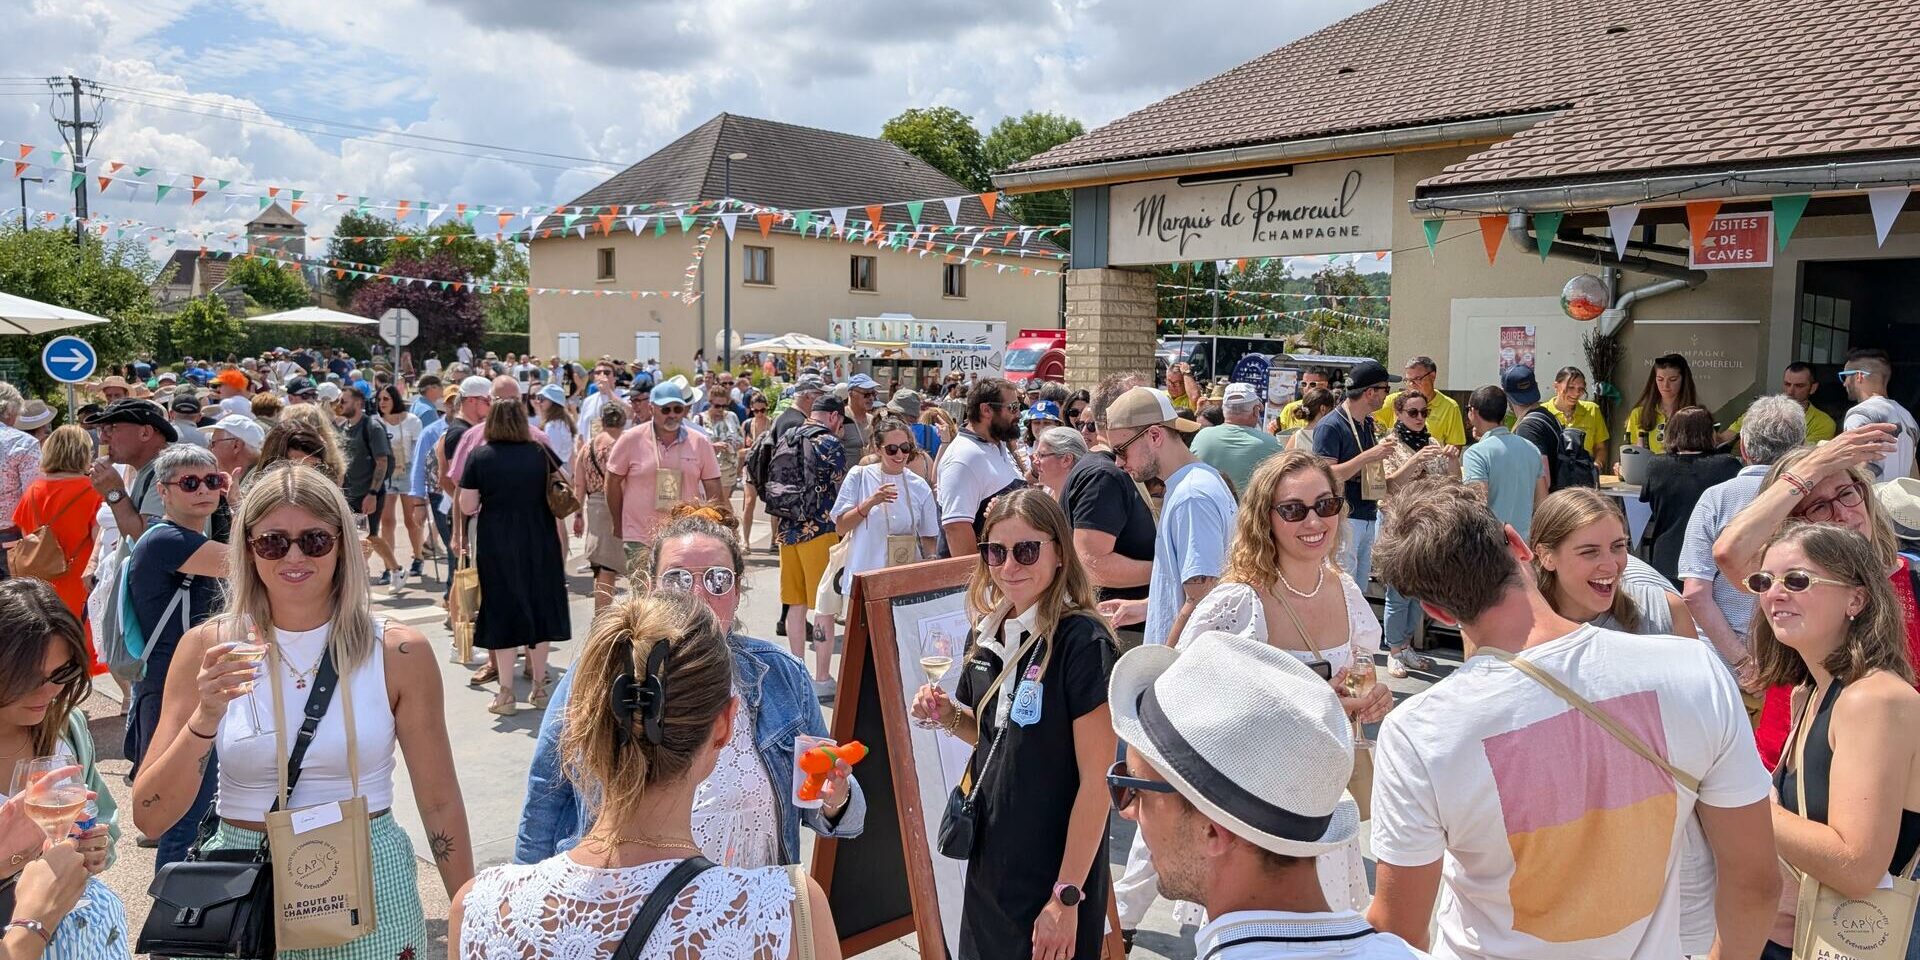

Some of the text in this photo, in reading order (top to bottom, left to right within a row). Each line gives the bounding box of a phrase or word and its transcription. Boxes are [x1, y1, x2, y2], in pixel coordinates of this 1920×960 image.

[1133, 170, 1362, 256] Marquis de Pomereuil
[1258, 225, 1361, 242] CHAMPAGNE
[1720, 234, 1737, 246] DE
[1706, 249, 1753, 261] CAVES
[950, 355, 987, 372] BRETON
[296, 897, 328, 908] ROUTE
[331, 894, 344, 903] DU
[284, 902, 345, 917] CHAMPAGNE
[1818, 949, 1830, 958] LA
